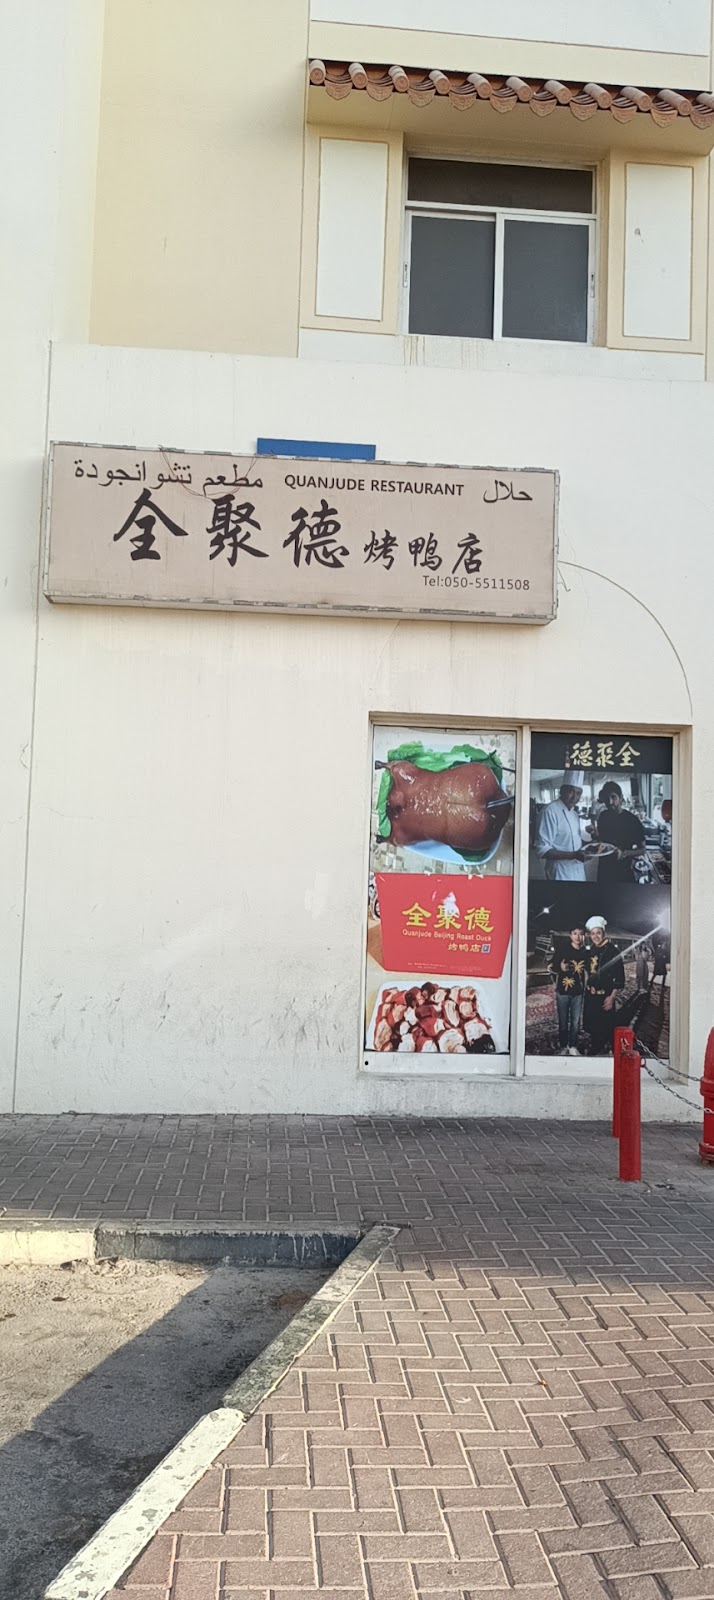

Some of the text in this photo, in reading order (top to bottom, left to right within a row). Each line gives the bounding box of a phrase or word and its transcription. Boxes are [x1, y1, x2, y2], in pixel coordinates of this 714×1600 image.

[203, 464, 263, 497] مطعم
[284, 474, 465, 496] QUANJUDE RESTAURANT
[483, 479, 533, 503] حلال
[422, 575, 530, 591] Tel:050-5511508
[402, 928, 492, 942] Quanjude Beijing Roast Duck
